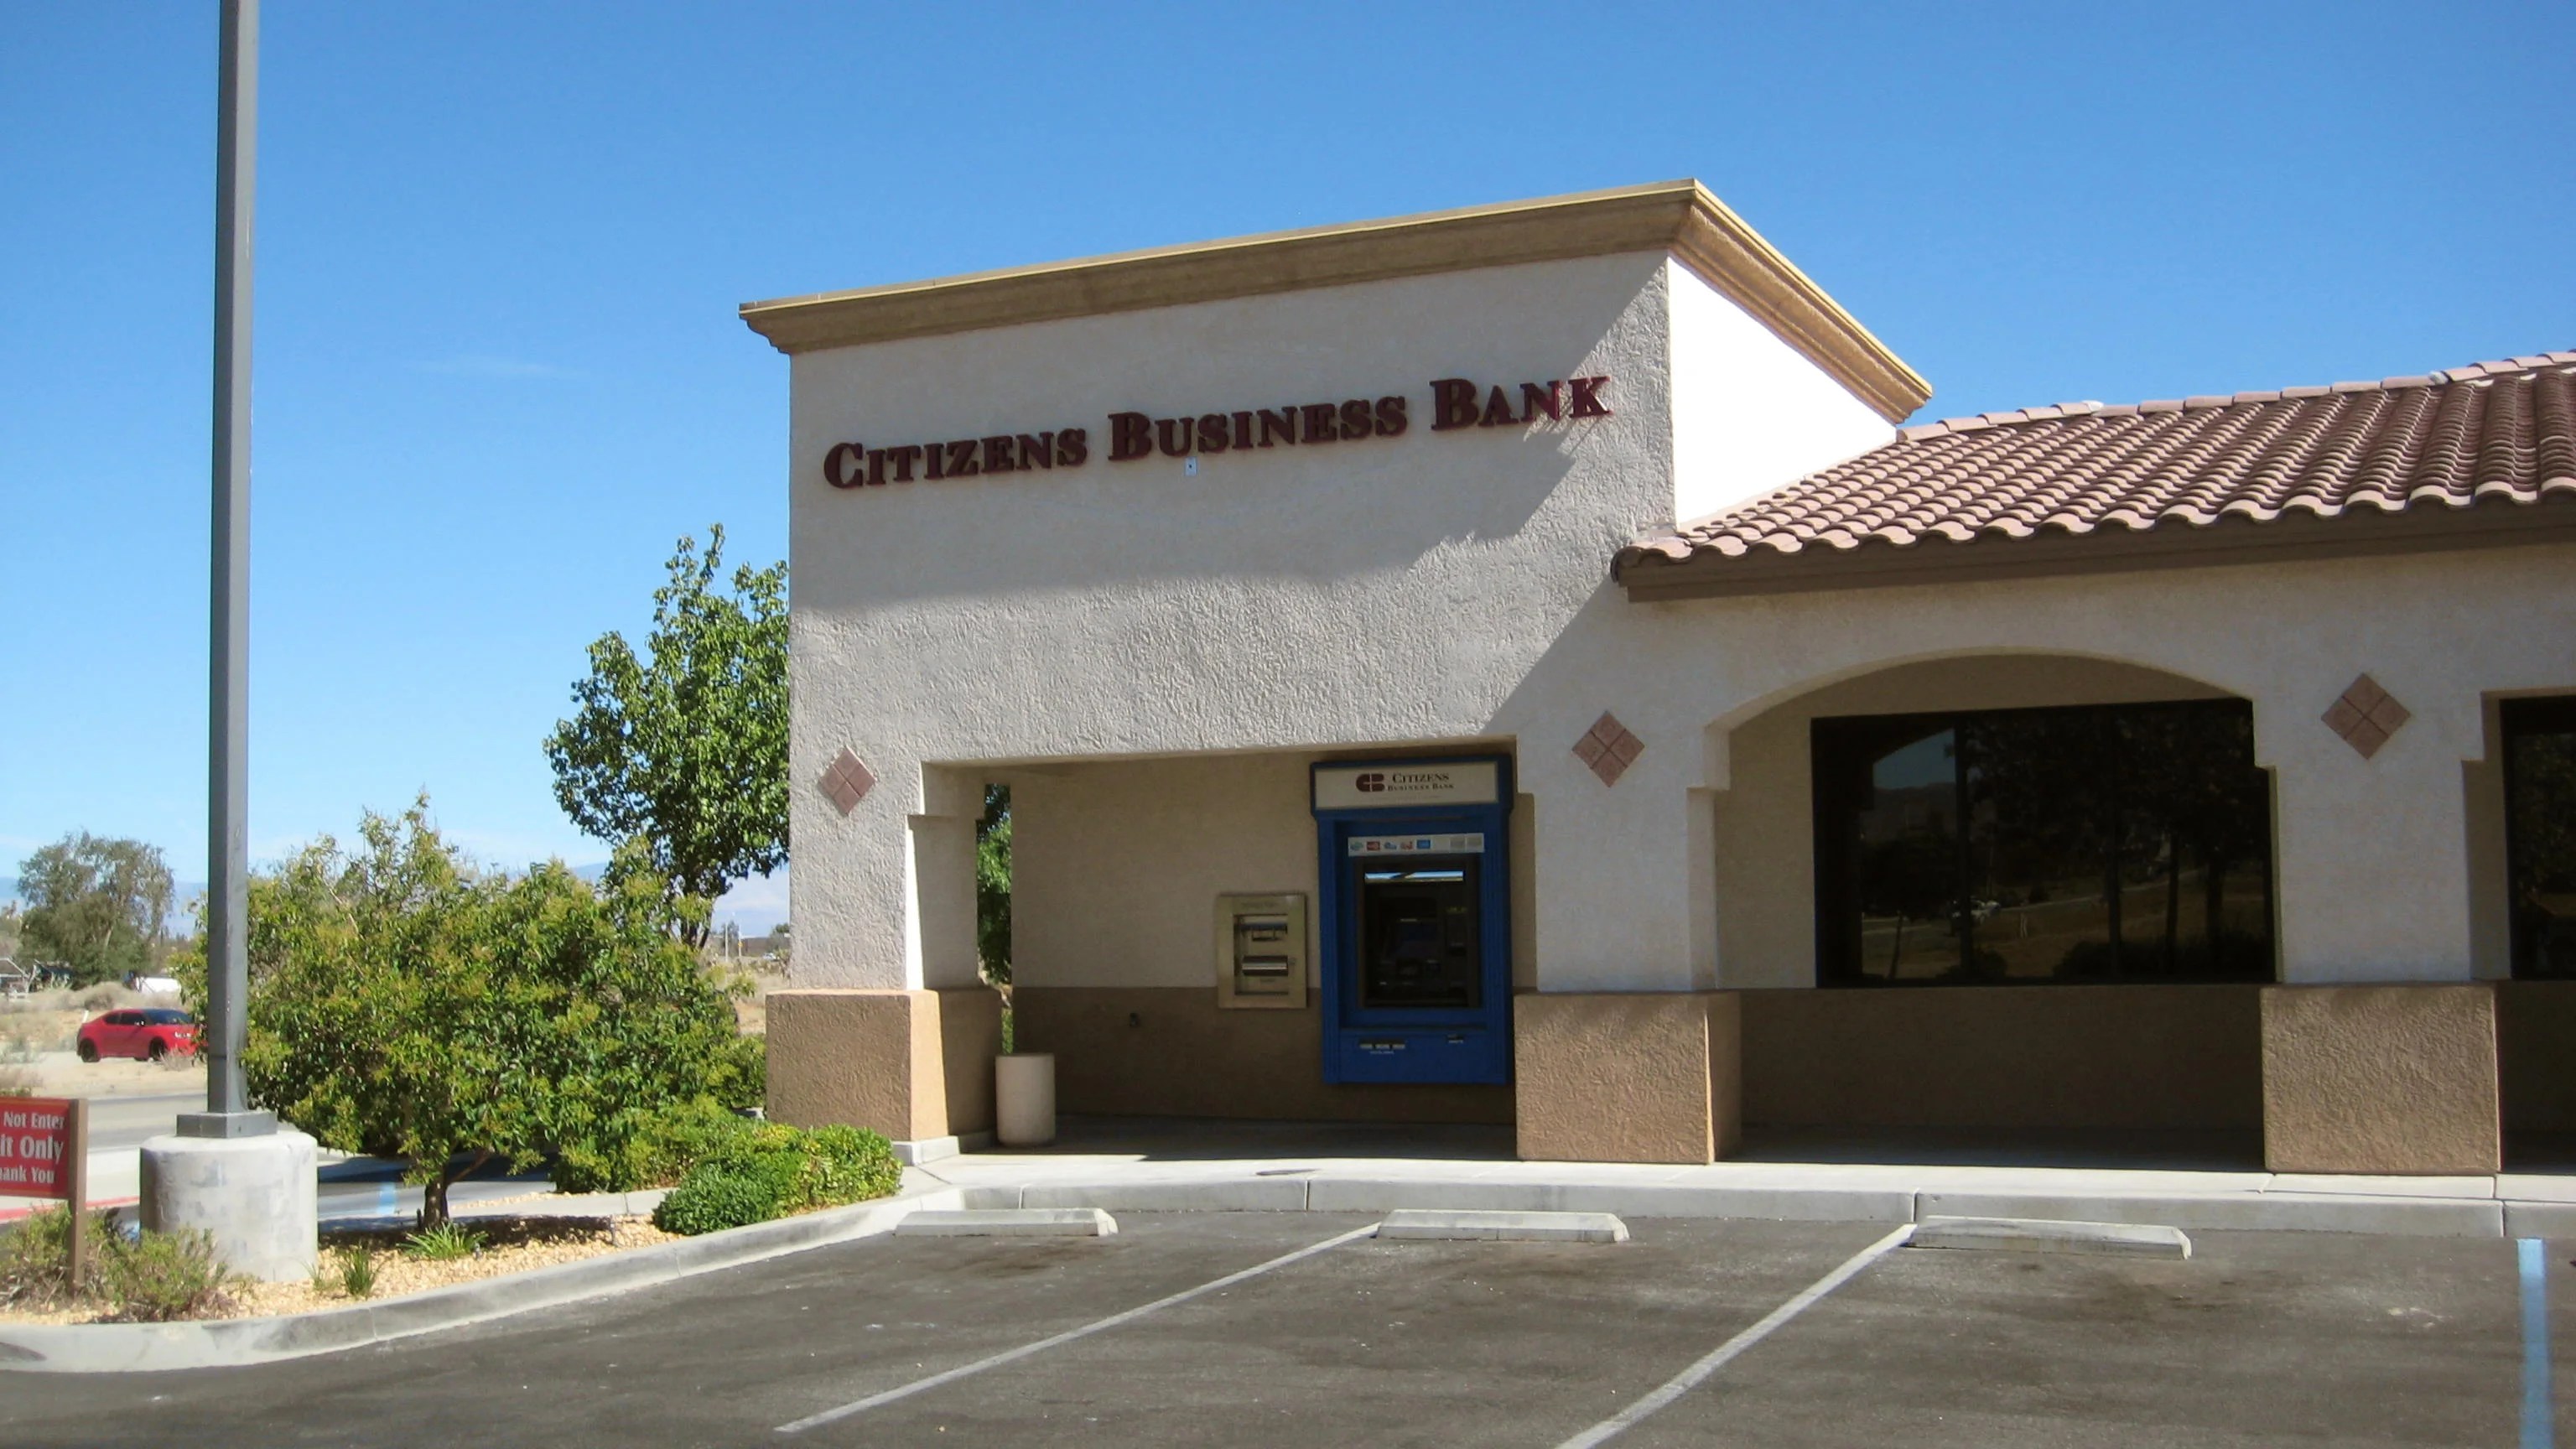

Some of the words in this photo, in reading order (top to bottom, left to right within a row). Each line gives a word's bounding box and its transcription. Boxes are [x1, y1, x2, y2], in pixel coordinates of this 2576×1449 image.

[823, 428, 1088, 488] CITIZENS
[1108, 396, 1407, 461] BUSINESS
[1429, 376, 1613, 430] BANK
[3, 1111, 27, 1128] Not
[31, 1112, 65, 1130] Enter
[19, 1135, 64, 1165] Only
[31, 1166, 55, 1183] You
